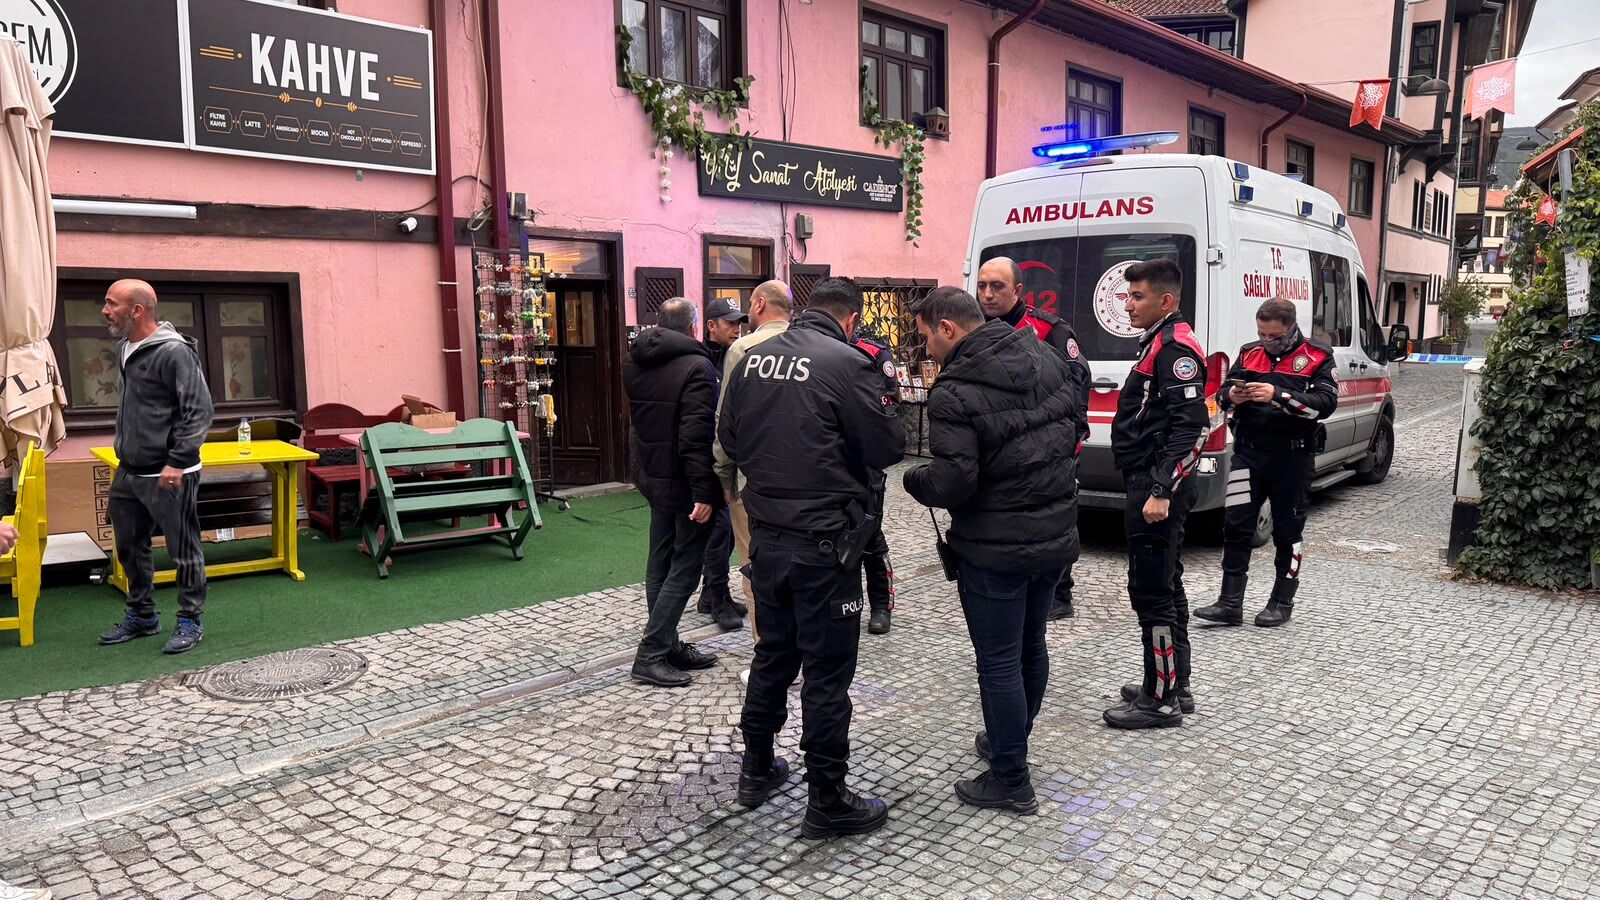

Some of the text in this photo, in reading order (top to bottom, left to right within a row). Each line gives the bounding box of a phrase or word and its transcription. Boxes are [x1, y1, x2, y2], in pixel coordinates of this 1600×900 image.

[251, 32, 380, 101] KAHVE
[209, 120, 227, 128] KAHVE
[244, 120, 262, 129] LATTE
[310, 128, 330, 137] MOCHA
[340, 134, 362, 142] CHOCOLATE
[401, 140, 422, 148] ESPRESSO
[749, 150, 799, 186] Sanat
[803, 160, 858, 201] Atölyesi
[862, 182, 897, 195] CADENCE
[1005, 196, 1155, 226] AMBULANS
[1270, 246, 1285, 271] T.C.
[1243, 269, 1309, 301] SAĞLIK BAKANLIĞI
